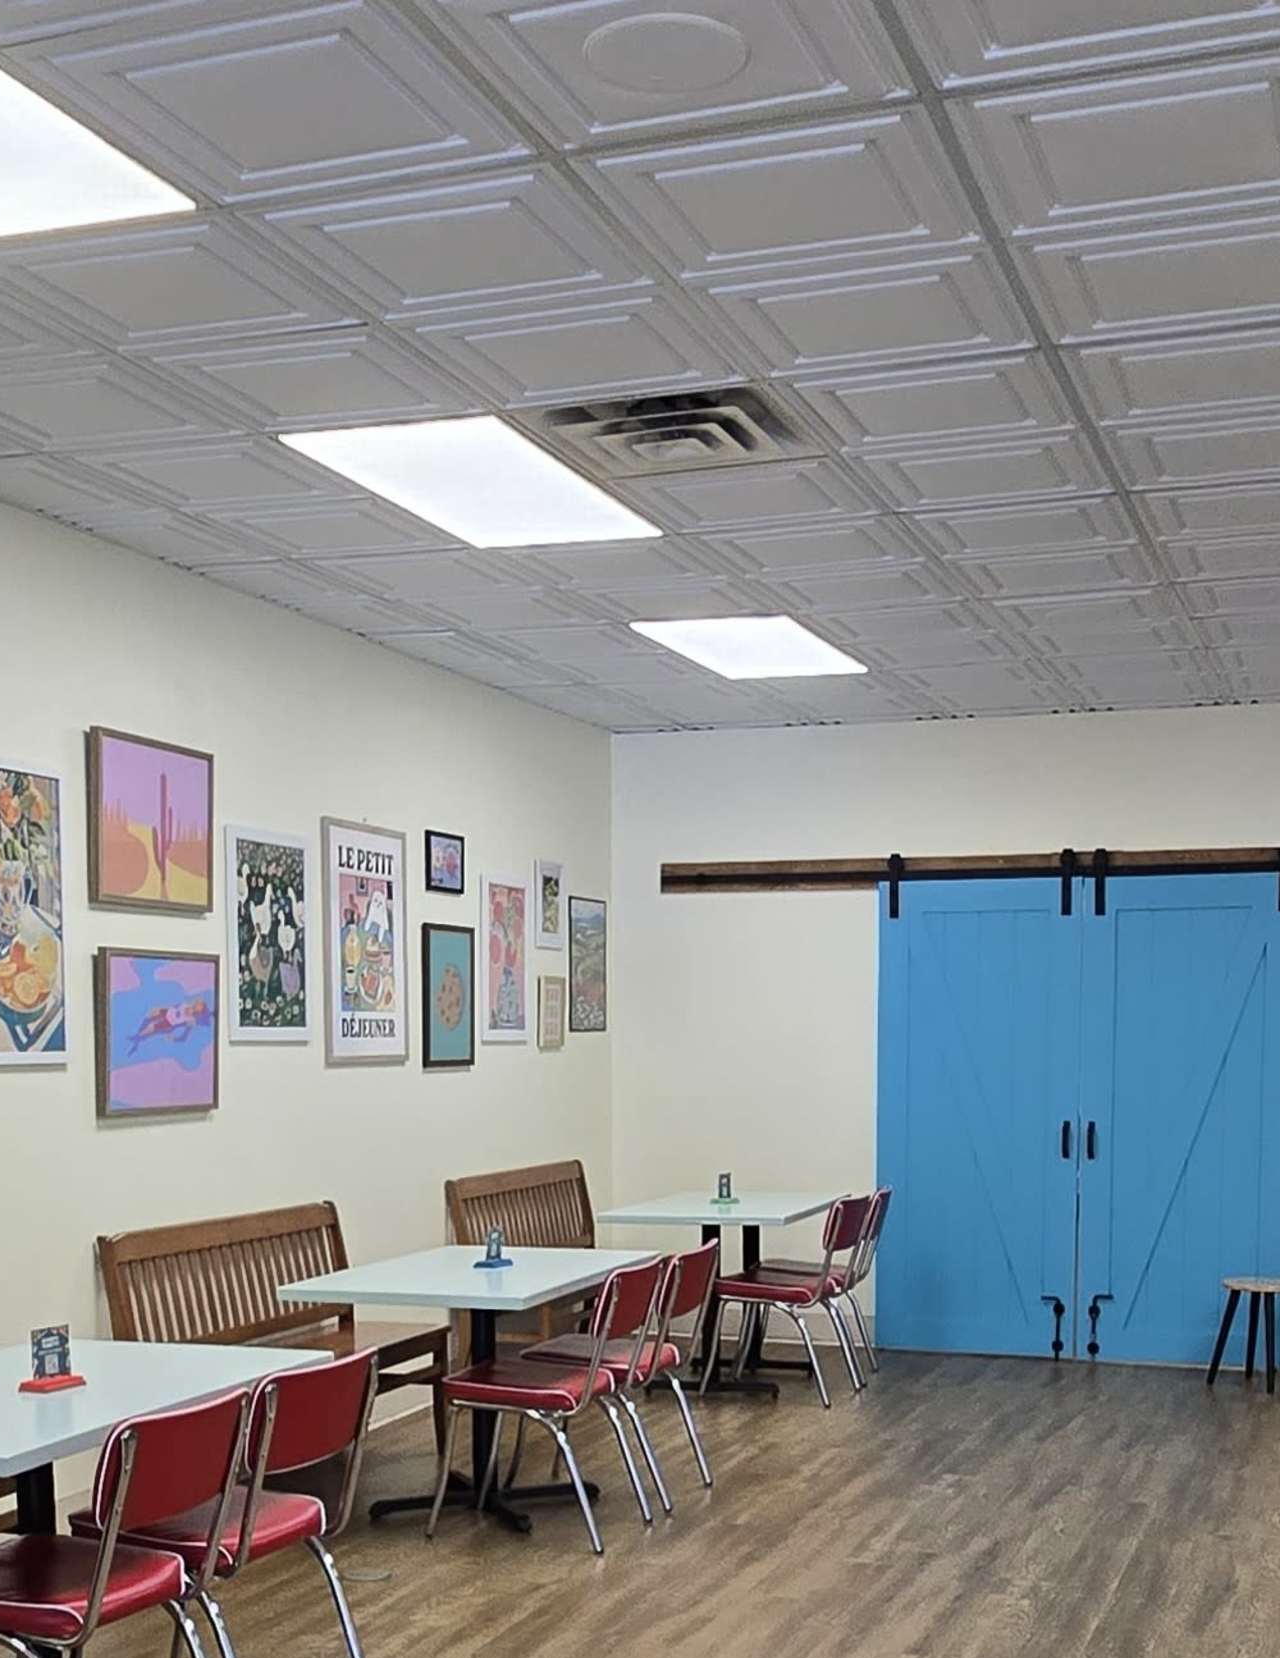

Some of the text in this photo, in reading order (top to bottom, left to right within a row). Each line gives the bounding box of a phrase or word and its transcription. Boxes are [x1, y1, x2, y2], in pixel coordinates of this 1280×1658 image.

[338, 845, 394, 875] LE PETIT
[341, 1012, 396, 1038] DÉJEUNER
